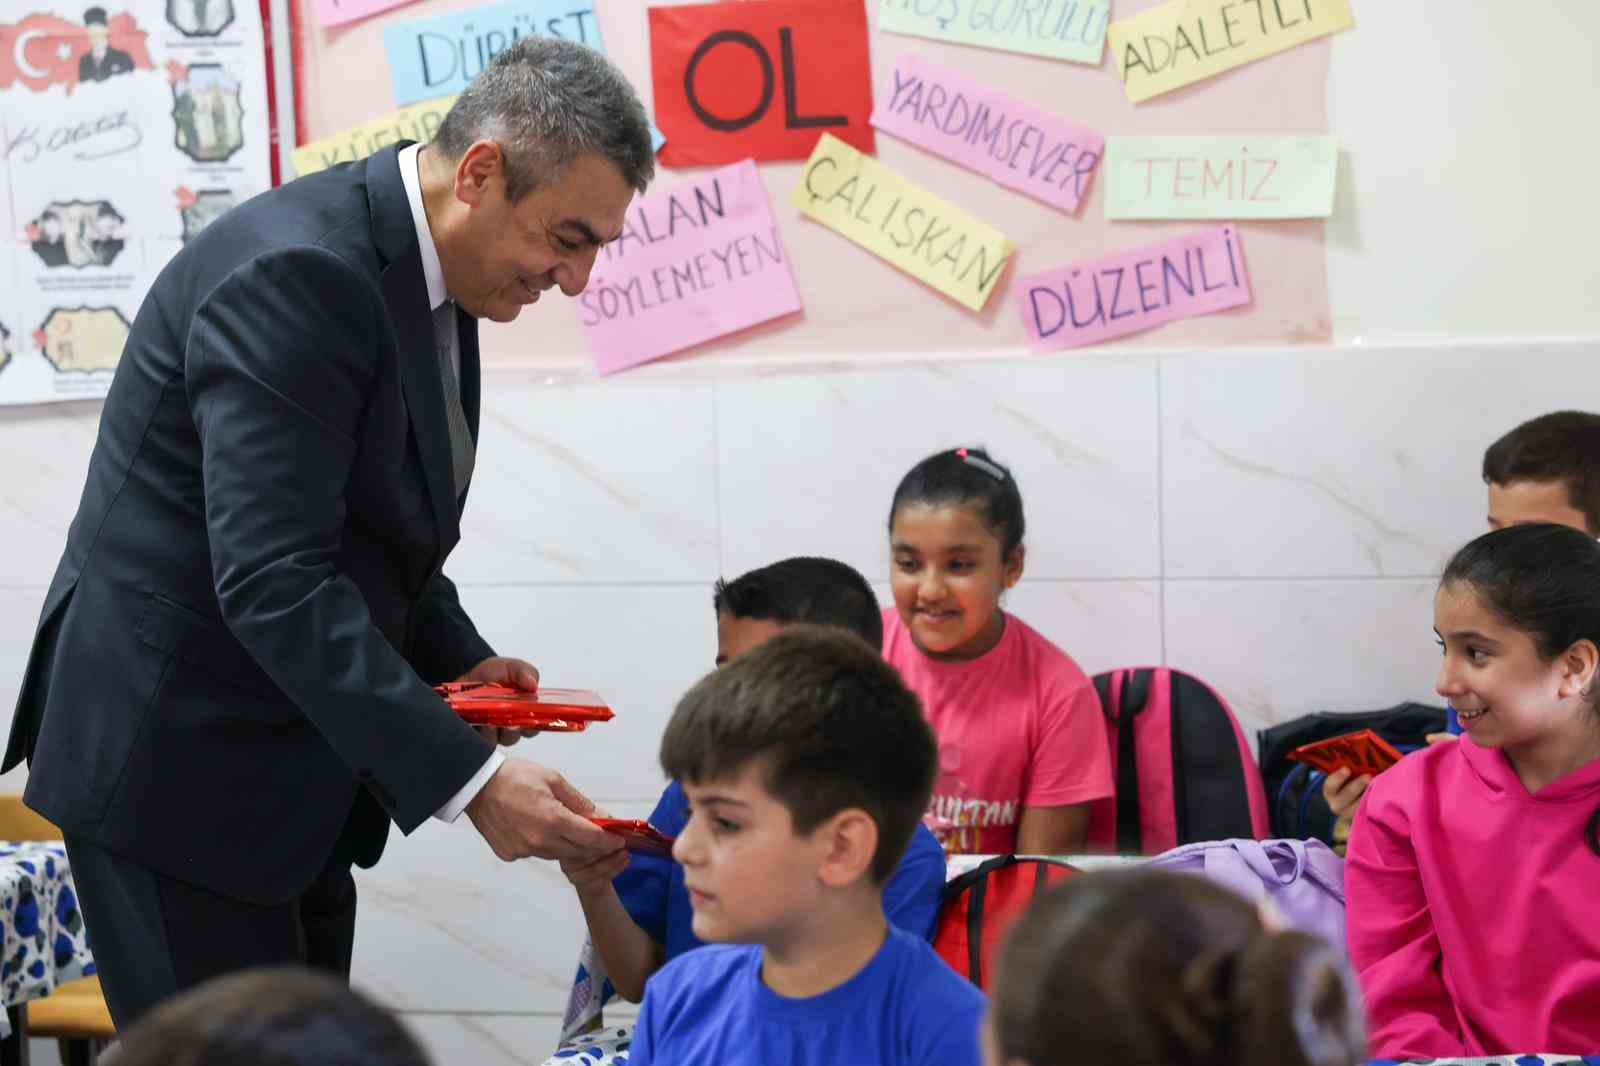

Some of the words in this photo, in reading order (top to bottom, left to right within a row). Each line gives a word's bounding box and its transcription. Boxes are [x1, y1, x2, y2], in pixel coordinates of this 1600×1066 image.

[684, 27, 848, 132] OL
[888, 68, 1099, 199] YARDIMSEVER
[1133, 146, 1281, 202] TEMİZ
[581, 226, 782, 326] SÖYLEMEYEN
[1029, 228, 1239, 337] DÜZENLİ
